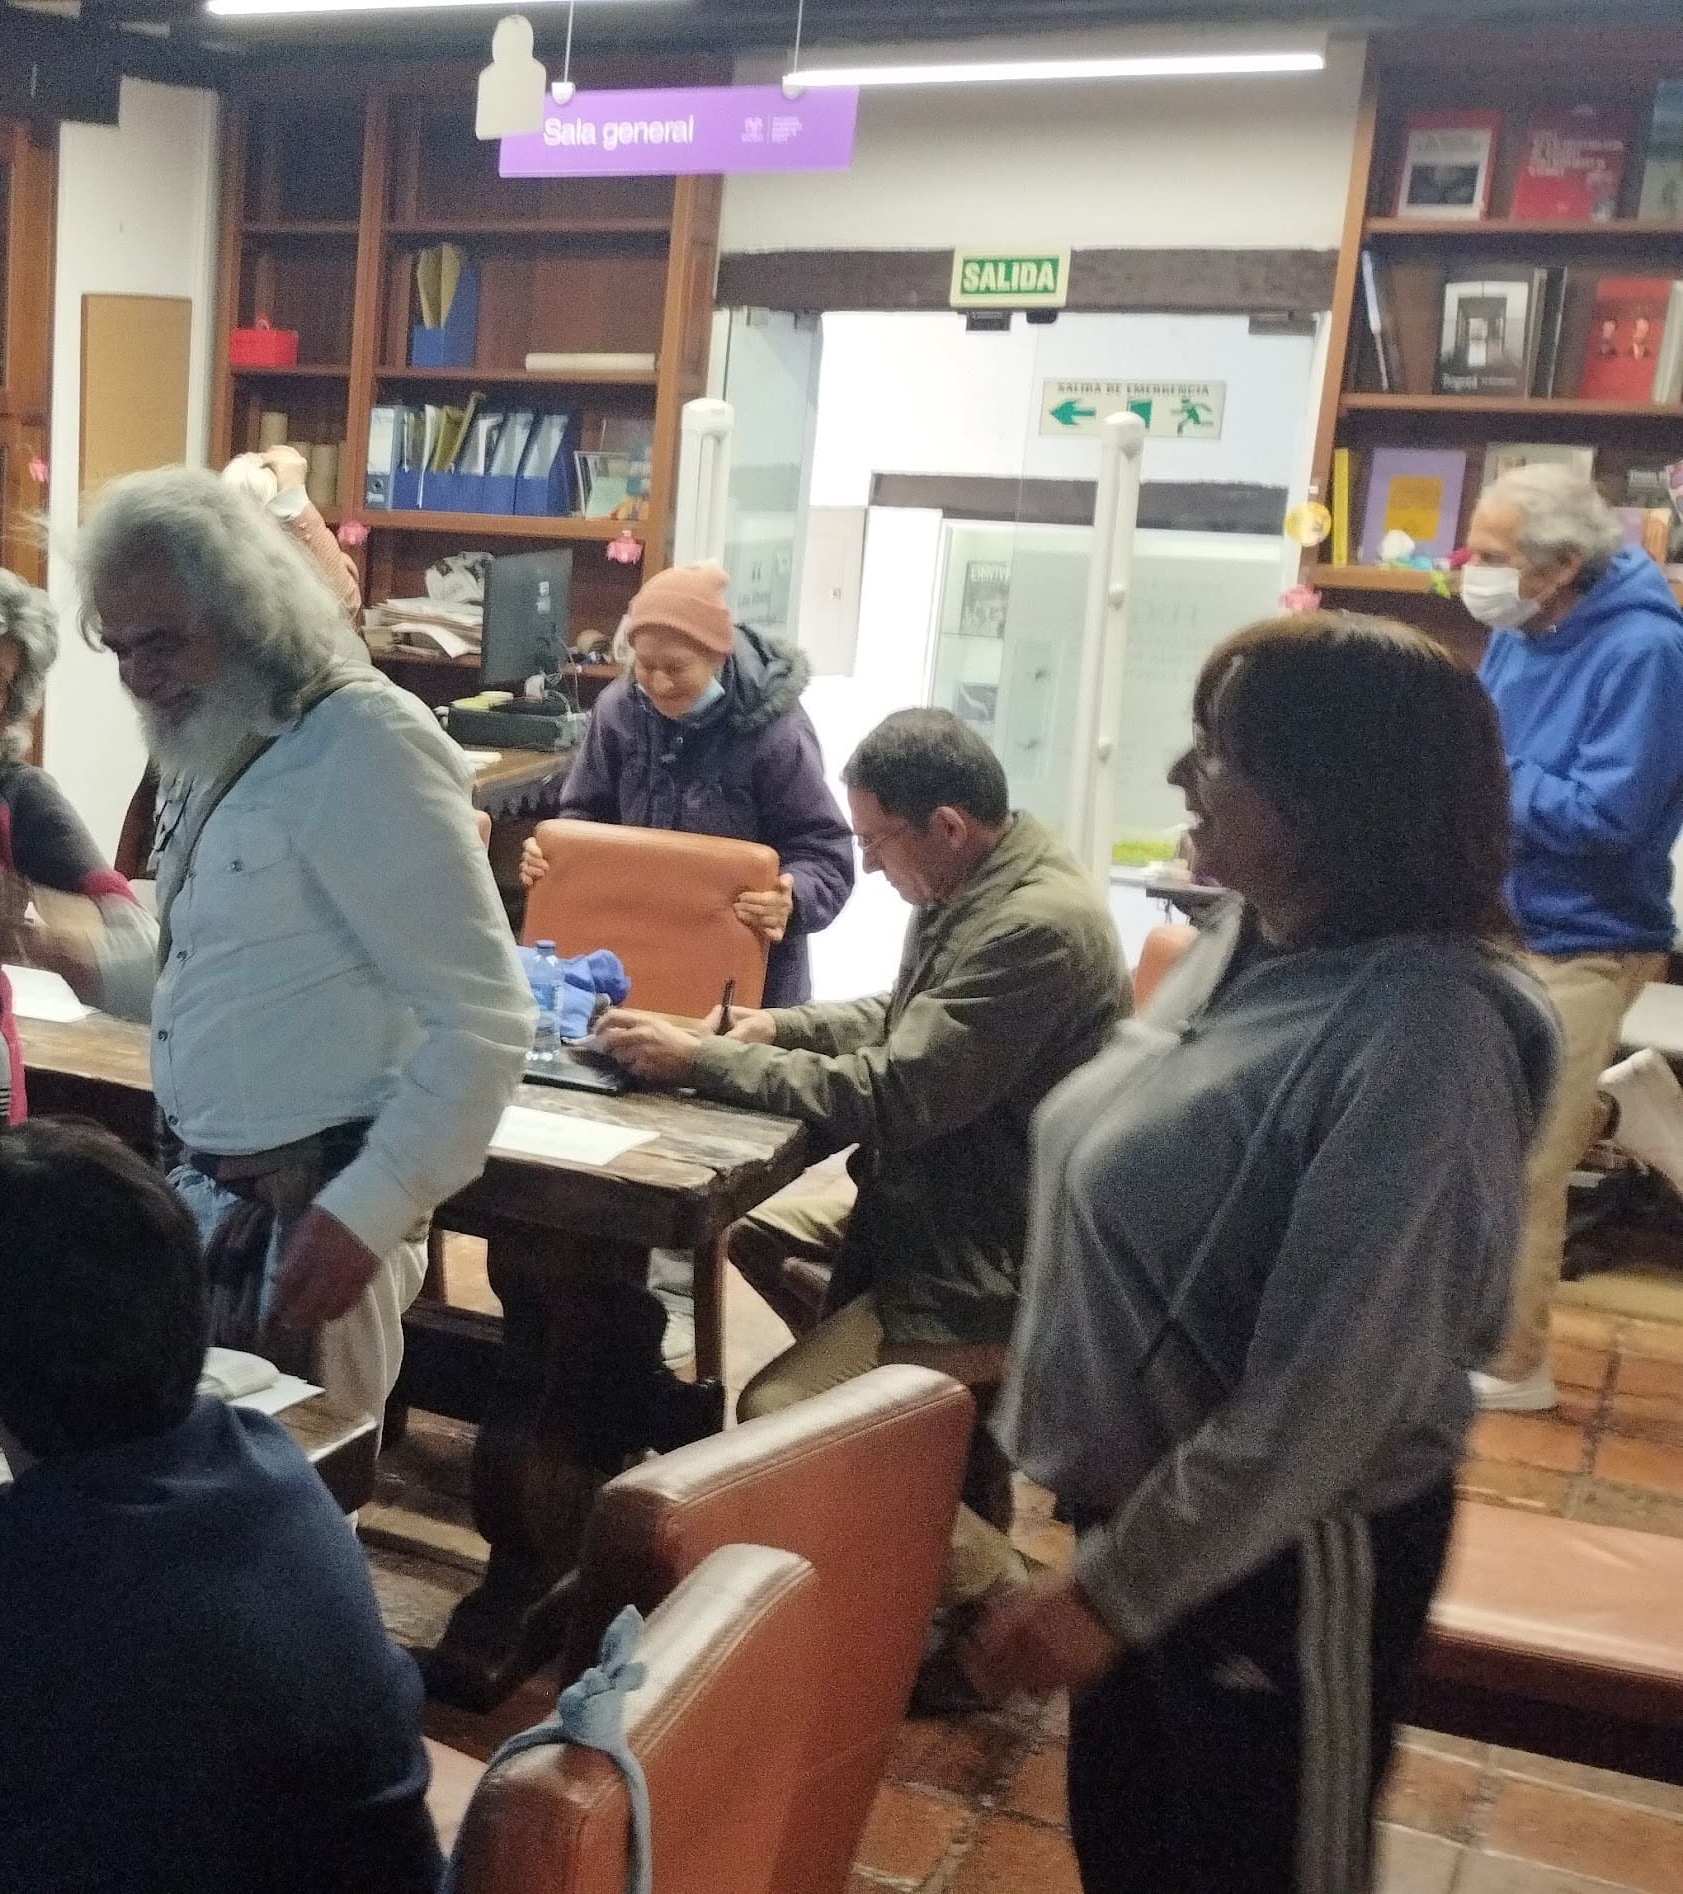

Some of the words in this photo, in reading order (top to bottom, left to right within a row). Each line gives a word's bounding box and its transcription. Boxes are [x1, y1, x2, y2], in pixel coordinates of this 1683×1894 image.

[543, 117, 597, 146] Sala
[602, 114, 695, 151] general
[963, 261, 1055, 292] SALIDA
[1057, 381, 1102, 394] SALIDA
[1106, 382, 1123, 395] DE
[1126, 382, 1210, 396] EMERGENCIA
